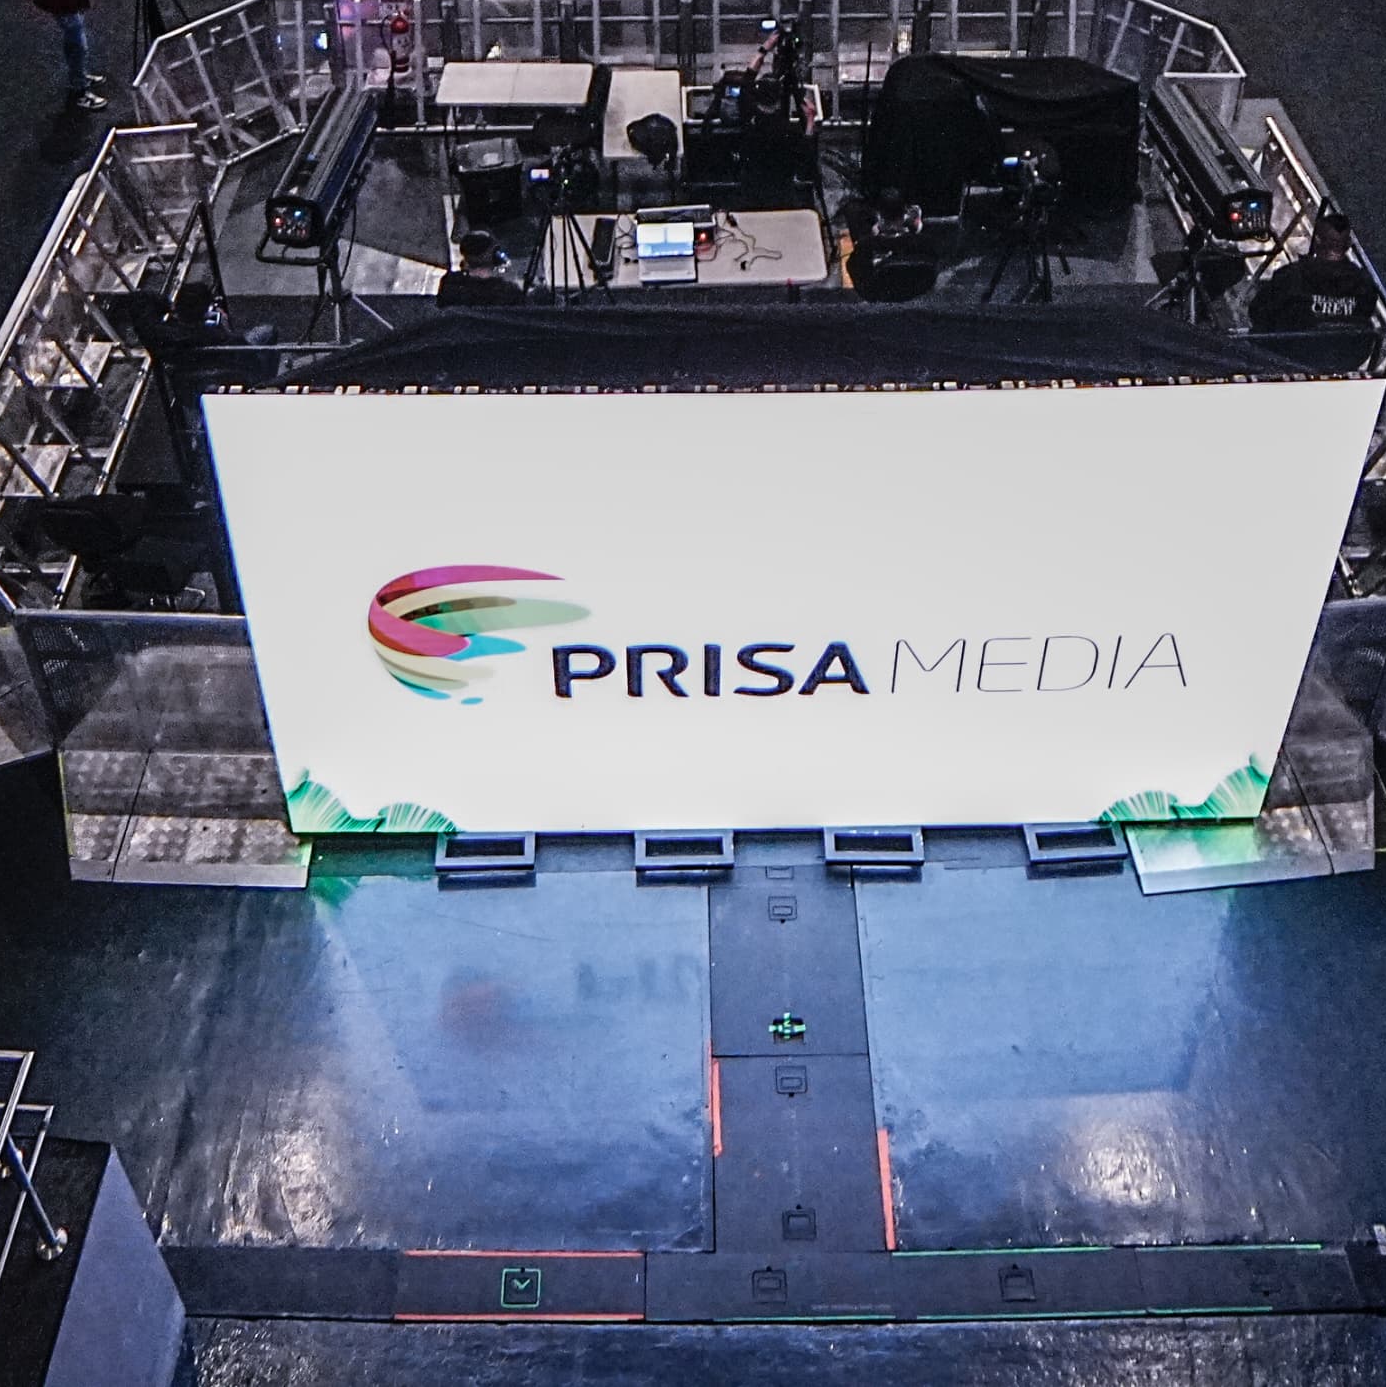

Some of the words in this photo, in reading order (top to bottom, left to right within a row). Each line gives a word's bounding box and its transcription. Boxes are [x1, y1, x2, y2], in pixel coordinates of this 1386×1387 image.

[1311, 302, 1355, 316] CREW
[552, 642, 870, 698] PRISA
[890, 632, 1189, 694] MEDIA
